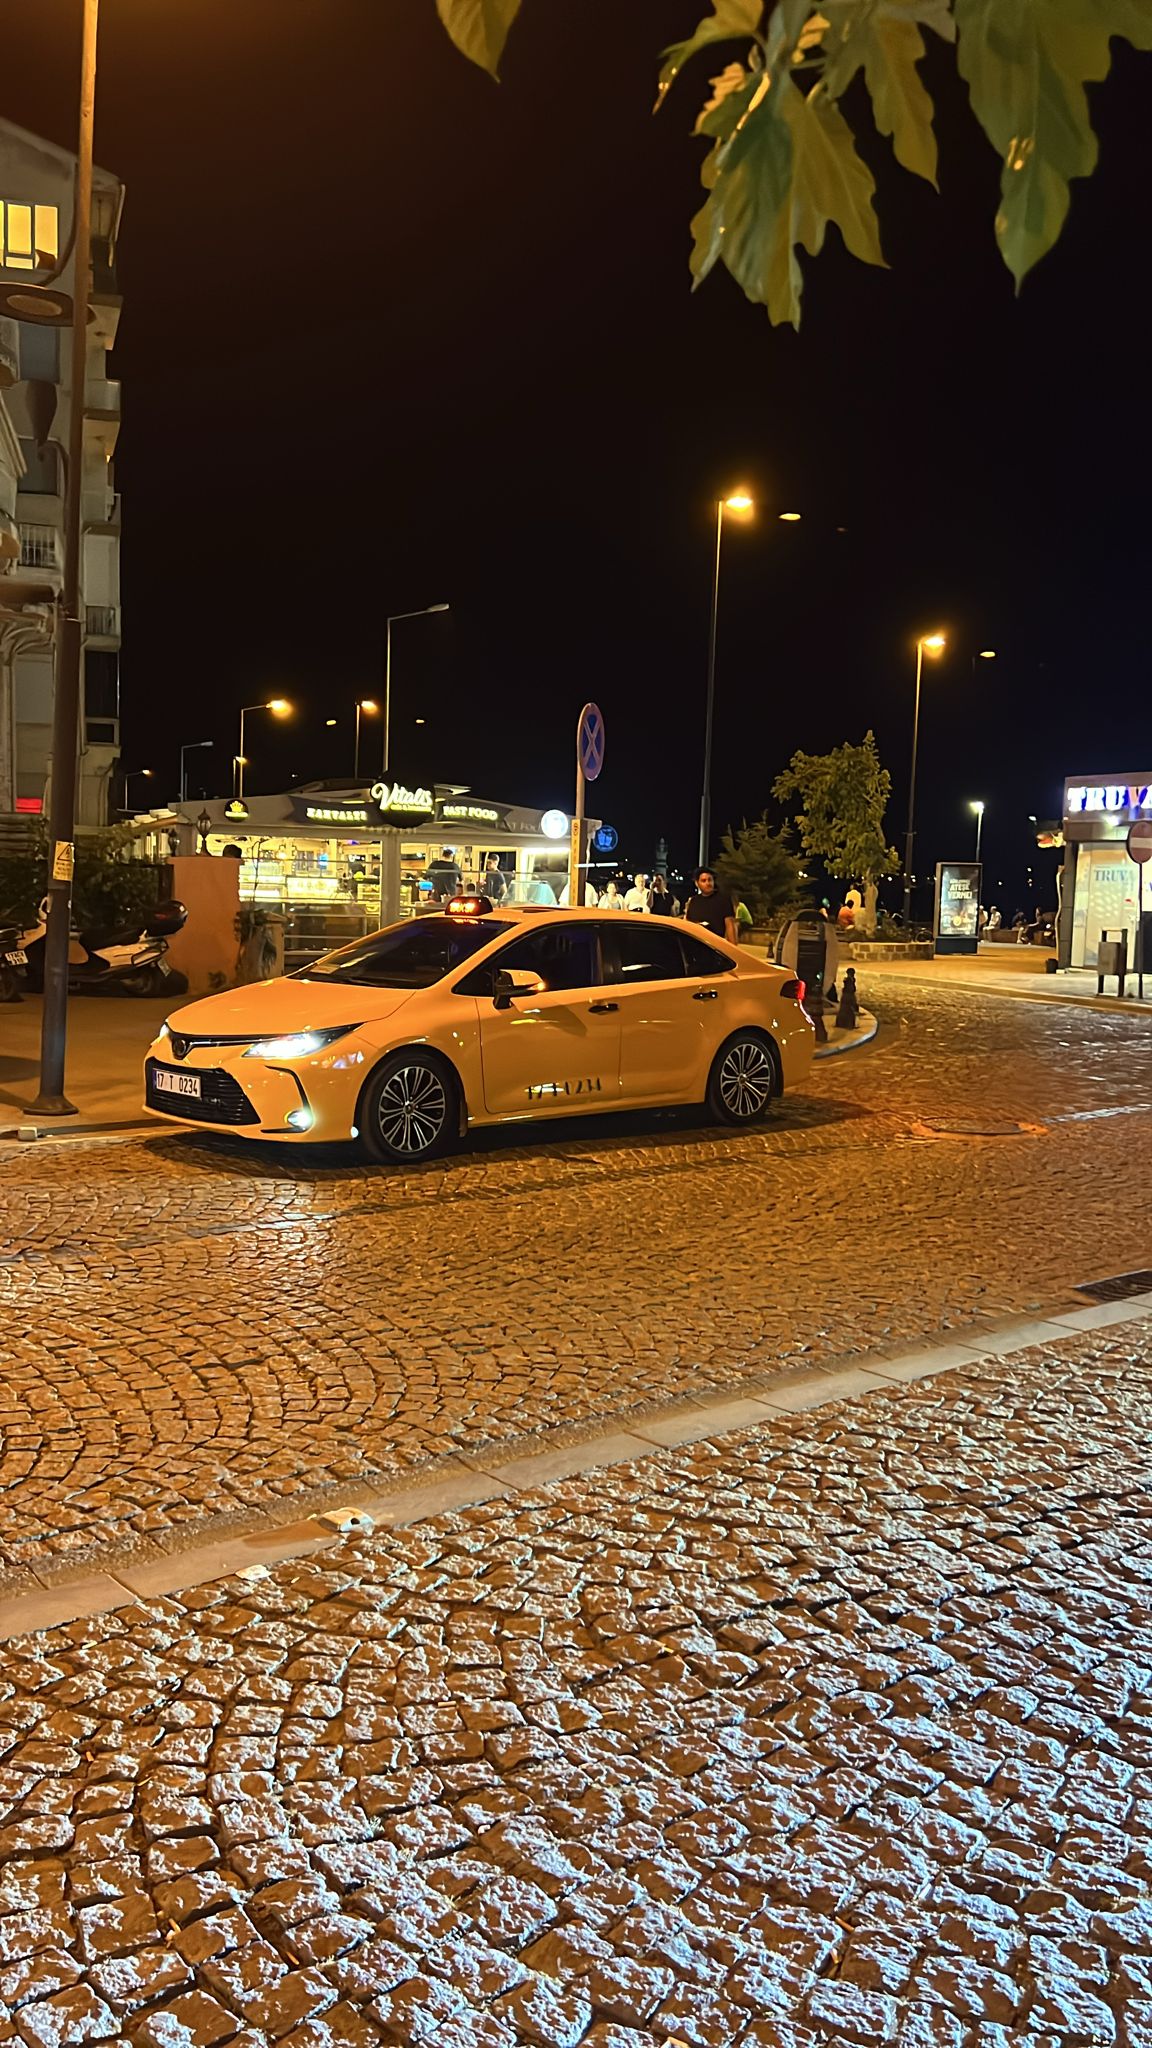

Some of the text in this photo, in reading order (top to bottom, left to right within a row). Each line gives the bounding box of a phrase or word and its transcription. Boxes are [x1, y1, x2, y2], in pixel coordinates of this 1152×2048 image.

[443, 805, 467, 817] FAST
[468, 806, 498, 821] FOOD
[157, 1073, 197, 1095] 17 T 0234
